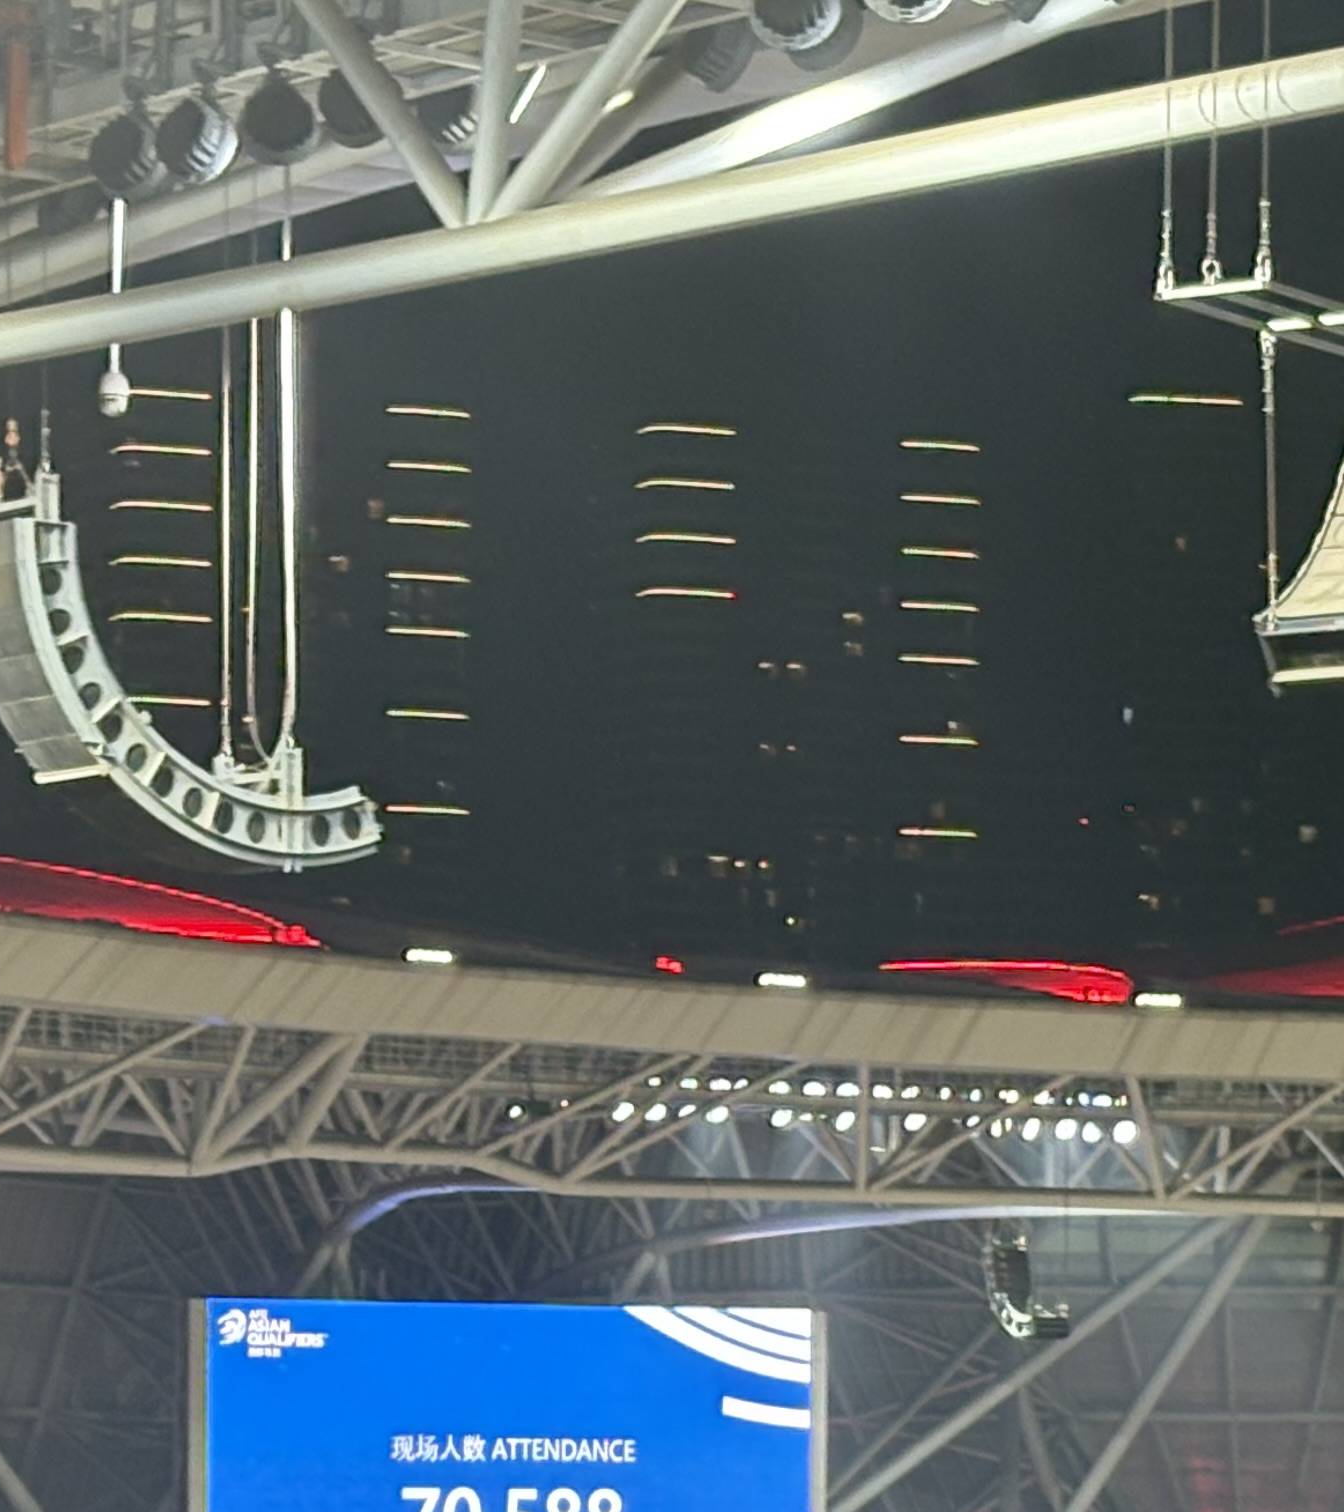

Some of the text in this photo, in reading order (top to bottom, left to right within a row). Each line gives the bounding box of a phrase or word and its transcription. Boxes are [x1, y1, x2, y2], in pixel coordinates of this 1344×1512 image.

[247, 1319, 291, 1332] ASIAN
[390, 1434, 637, 1464] 现场人数 ATTENDANCE
